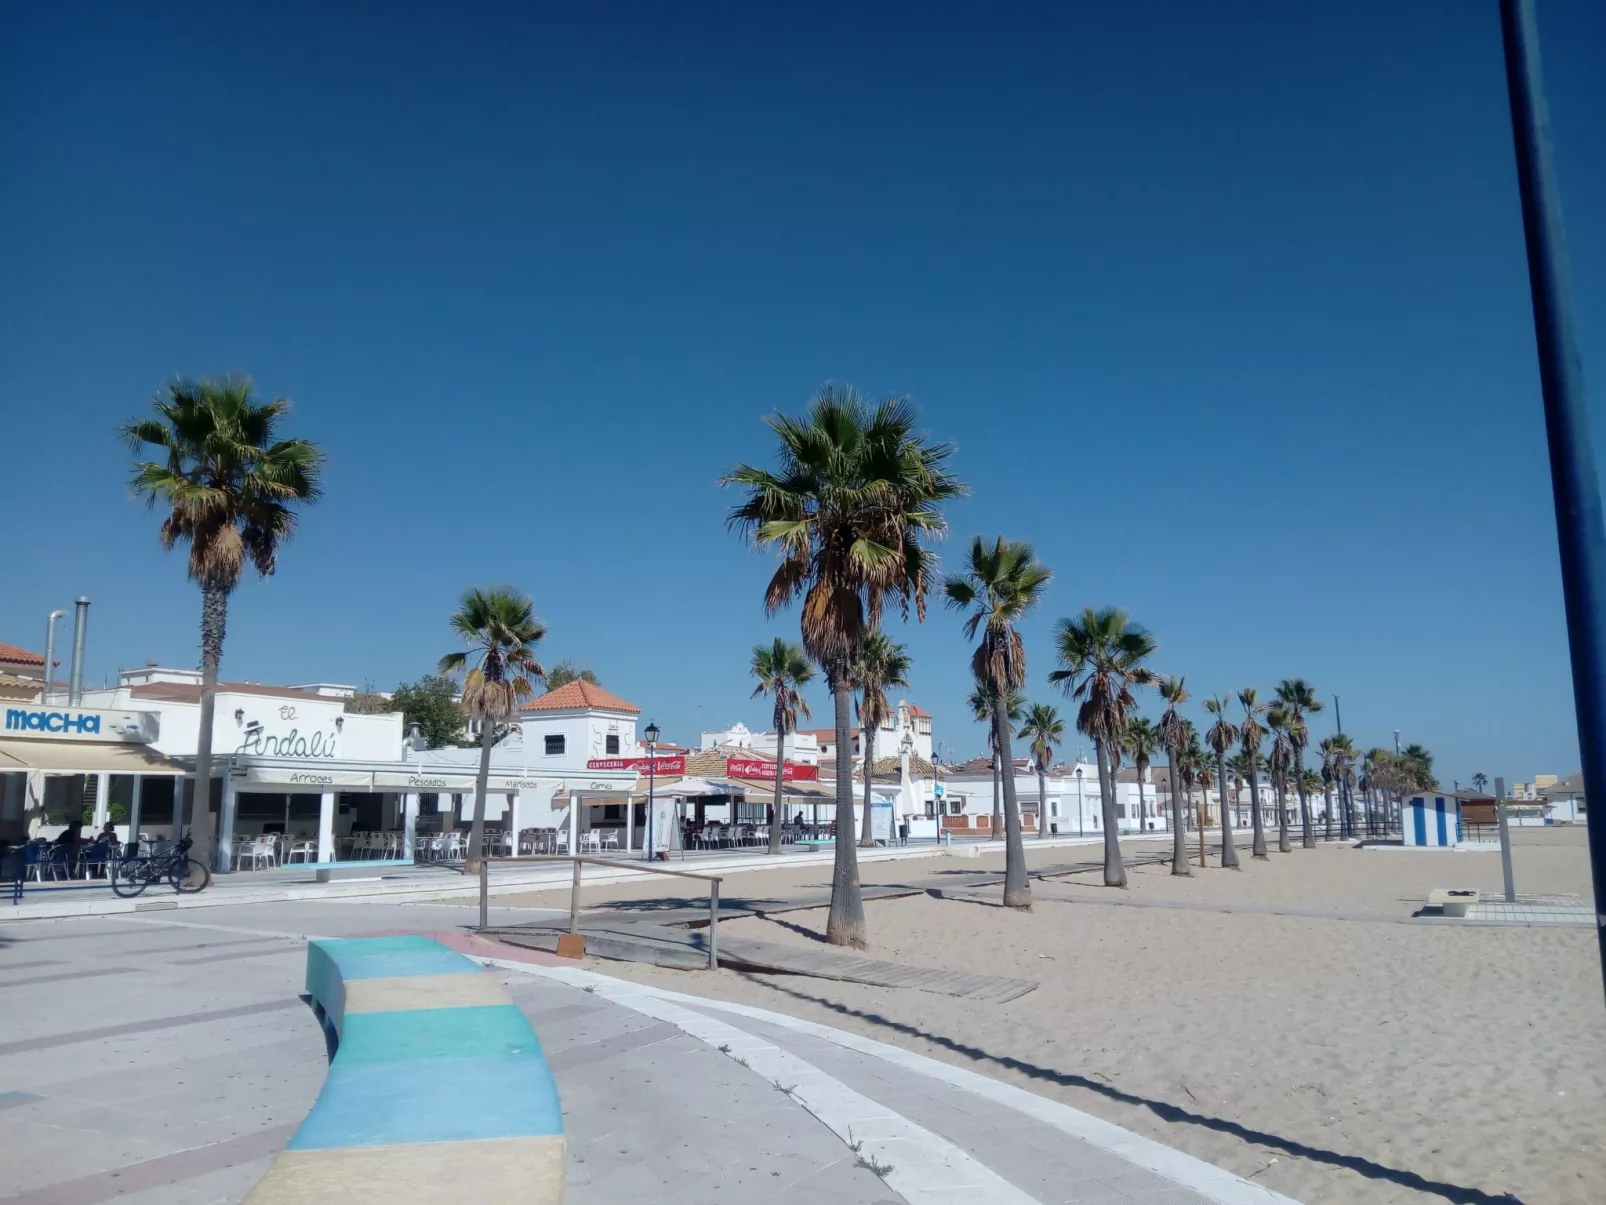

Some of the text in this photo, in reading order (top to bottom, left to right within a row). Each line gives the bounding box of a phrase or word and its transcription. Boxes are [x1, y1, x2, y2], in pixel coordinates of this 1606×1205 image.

[278, 705, 299, 720] El
[235, 728, 336, 758] Andalú
[289, 773, 333, 784] Arroces
[408, 776, 447, 787] Pescados
[505, 780, 538, 789] Mariscos
